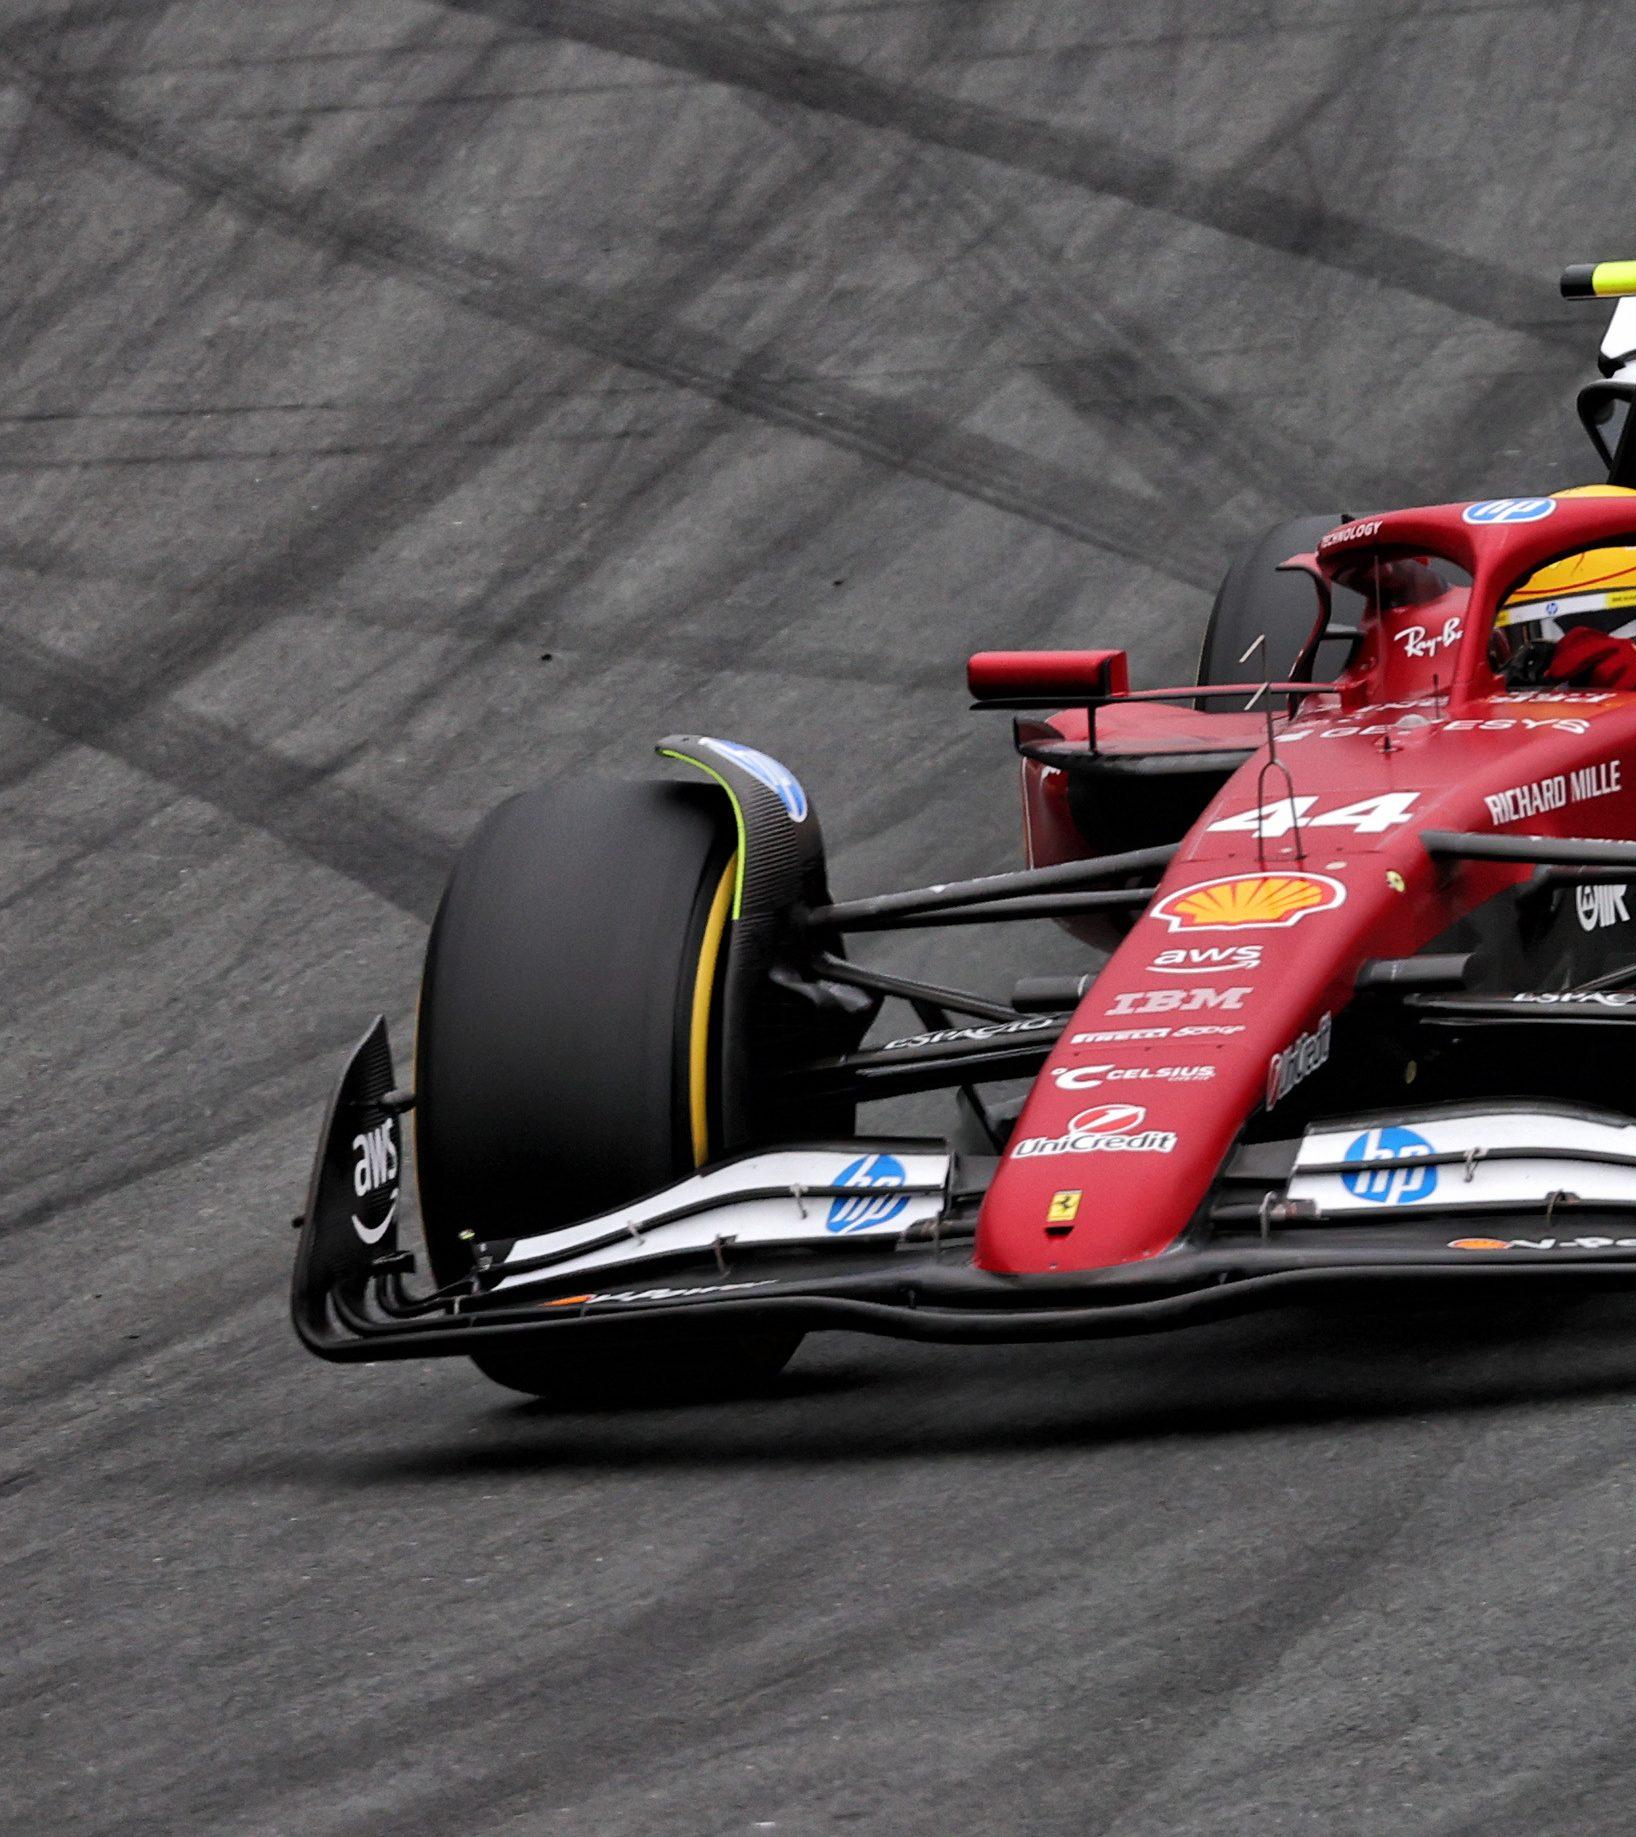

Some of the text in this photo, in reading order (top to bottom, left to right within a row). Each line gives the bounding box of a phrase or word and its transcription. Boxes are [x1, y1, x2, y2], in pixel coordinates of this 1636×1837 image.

[1394, 617, 1463, 658] Ray-B
[1320, 719, 1591, 737] GEESYS
[1484, 759, 1622, 825] RICHARD MILLE
[1206, 792, 1422, 839] 44
[1153, 945, 1264, 966] aws
[1105, 987, 1254, 1016] IBM
[1070, 1027, 1172, 1044] PIRELLI
[1106, 1066, 1217, 1080] CELSIUS
[353, 1118, 397, 1196] aws
[1011, 1133, 1178, 1159] UniCredit
[1348, 1128, 1435, 1204] hp
[828, 1155, 908, 1233] hp
